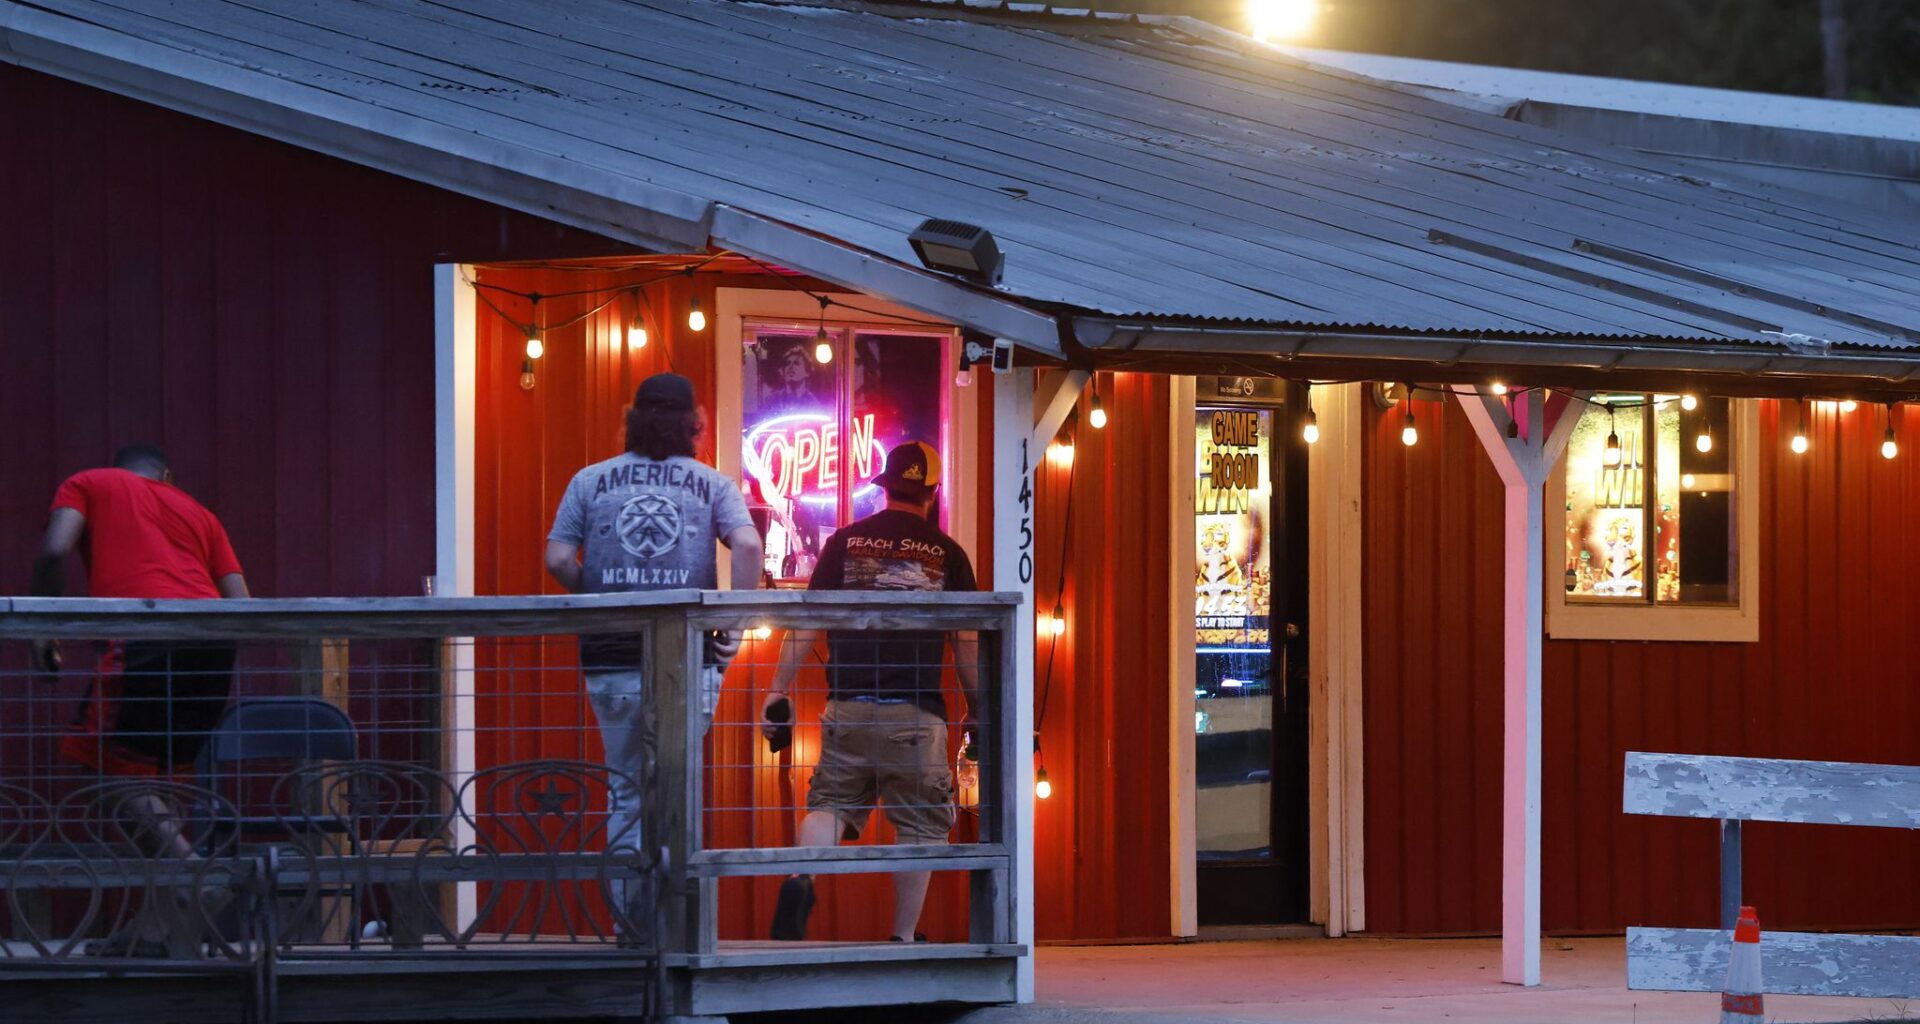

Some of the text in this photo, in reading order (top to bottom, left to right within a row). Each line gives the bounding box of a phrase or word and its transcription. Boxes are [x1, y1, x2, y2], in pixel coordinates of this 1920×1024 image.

[1211, 410, 1258, 446] GAME
[759, 413, 875, 499] OPEN
[1211, 453, 1259, 490] ROOM
[593, 463, 710, 505] AMERICAN
[1195, 477, 1248, 515] WIN
[1018, 438, 1032, 584] 1450
[846, 536, 894, 550] BEACH
[602, 567, 690, 585] MCMLXXIV
